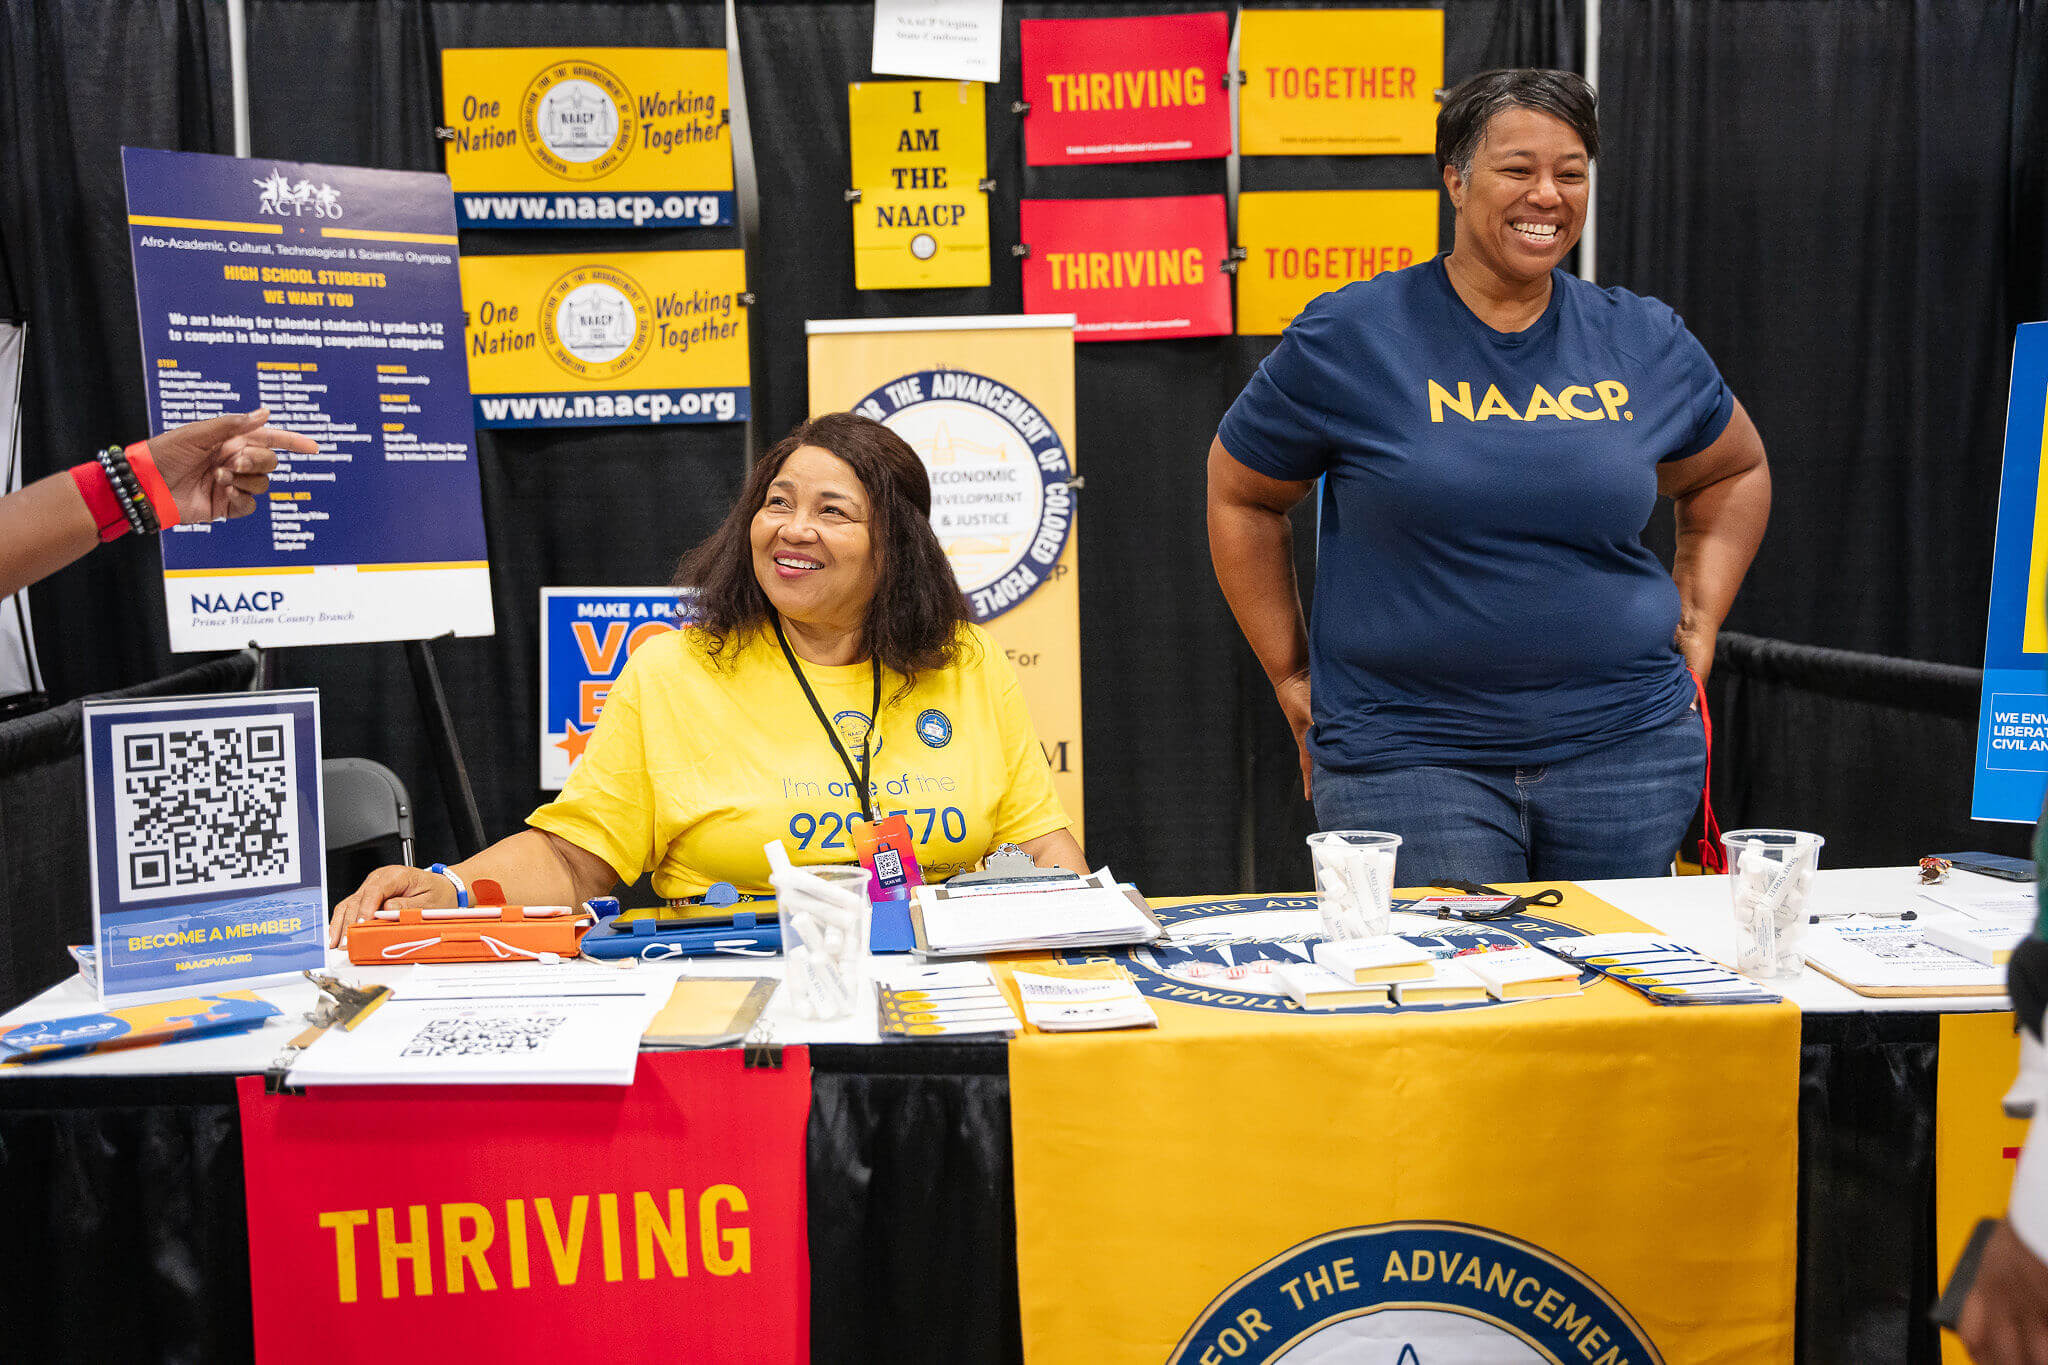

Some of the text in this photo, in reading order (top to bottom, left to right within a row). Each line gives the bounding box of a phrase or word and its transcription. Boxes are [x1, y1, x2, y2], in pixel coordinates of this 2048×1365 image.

[1046, 67, 1206, 113] THRIVING
[1266, 67, 1416, 99] TOGETHER
[463, 96, 500, 122] One
[639, 91, 716, 121] Working
[912, 91, 922, 113] I
[456, 127, 517, 153] Nation
[642, 123, 723, 155] Together
[897, 129, 940, 151] AM
[892, 168, 947, 190] THE
[462, 195, 719, 226] www.naacp.org
[876, 205, 966, 228] NAACP
[223, 264, 387, 288] HIGH SCHOOL STUDENTS
[1046, 248, 1204, 291] THRIVING
[263, 290, 354, 307] WE WANT YOU
[656, 291, 731, 319] Working
[168, 312, 187, 326] We
[190, 315, 209, 326] are
[211, 314, 254, 330] looking
[255, 316, 272, 329] for
[274, 317, 321, 331] talented
[321, 319, 369, 332] students
[370, 320, 381, 333] in
[382, 321, 418, 335] grades
[480, 301, 519, 325] One
[168, 328, 444, 351] to compete in the following competition categories
[473, 330, 536, 357] Nation
[659, 321, 738, 354] Together
[885, 378, 923, 404] THE
[480, 391, 736, 423] www.naacp.org
[856, 398, 886, 422] OR
[931, 374, 1051, 441] ADVANCEMENT
[1038, 447, 1066, 473] OF
[932, 469, 1016, 484] ECONOMIC
[930, 491, 1022, 506] EVELOPMENT
[956, 512, 1010, 526] JUSTICE
[1032, 483, 1070, 565] COLORED
[191, 591, 283, 613] NAACP
[971, 565, 1038, 618] PEOPLE
[192, 611, 355, 628] Prince William County Branch
[577, 603, 700, 618] MAKE A PLA
[1994, 712, 2019, 723] WE
[1992, 739, 2027, 751] CIVIL
[783, 777, 821, 798] I'm
[886, 774, 909, 795] of
[916, 773, 956, 793] the
[1180, 903, 1247, 916] THE
[128, 918, 302, 951] BECOME A MEMBER
[1512, 922, 1555, 933] OF
[175, 953, 253, 972] NAACPVA.ORG
[1152, 982, 1300, 1011] ATIONAL
[319, 1184, 752, 1303] THRIVING
[1199, 1307, 1273, 1365] FOR
[1280, 1257, 1360, 1311] THE
